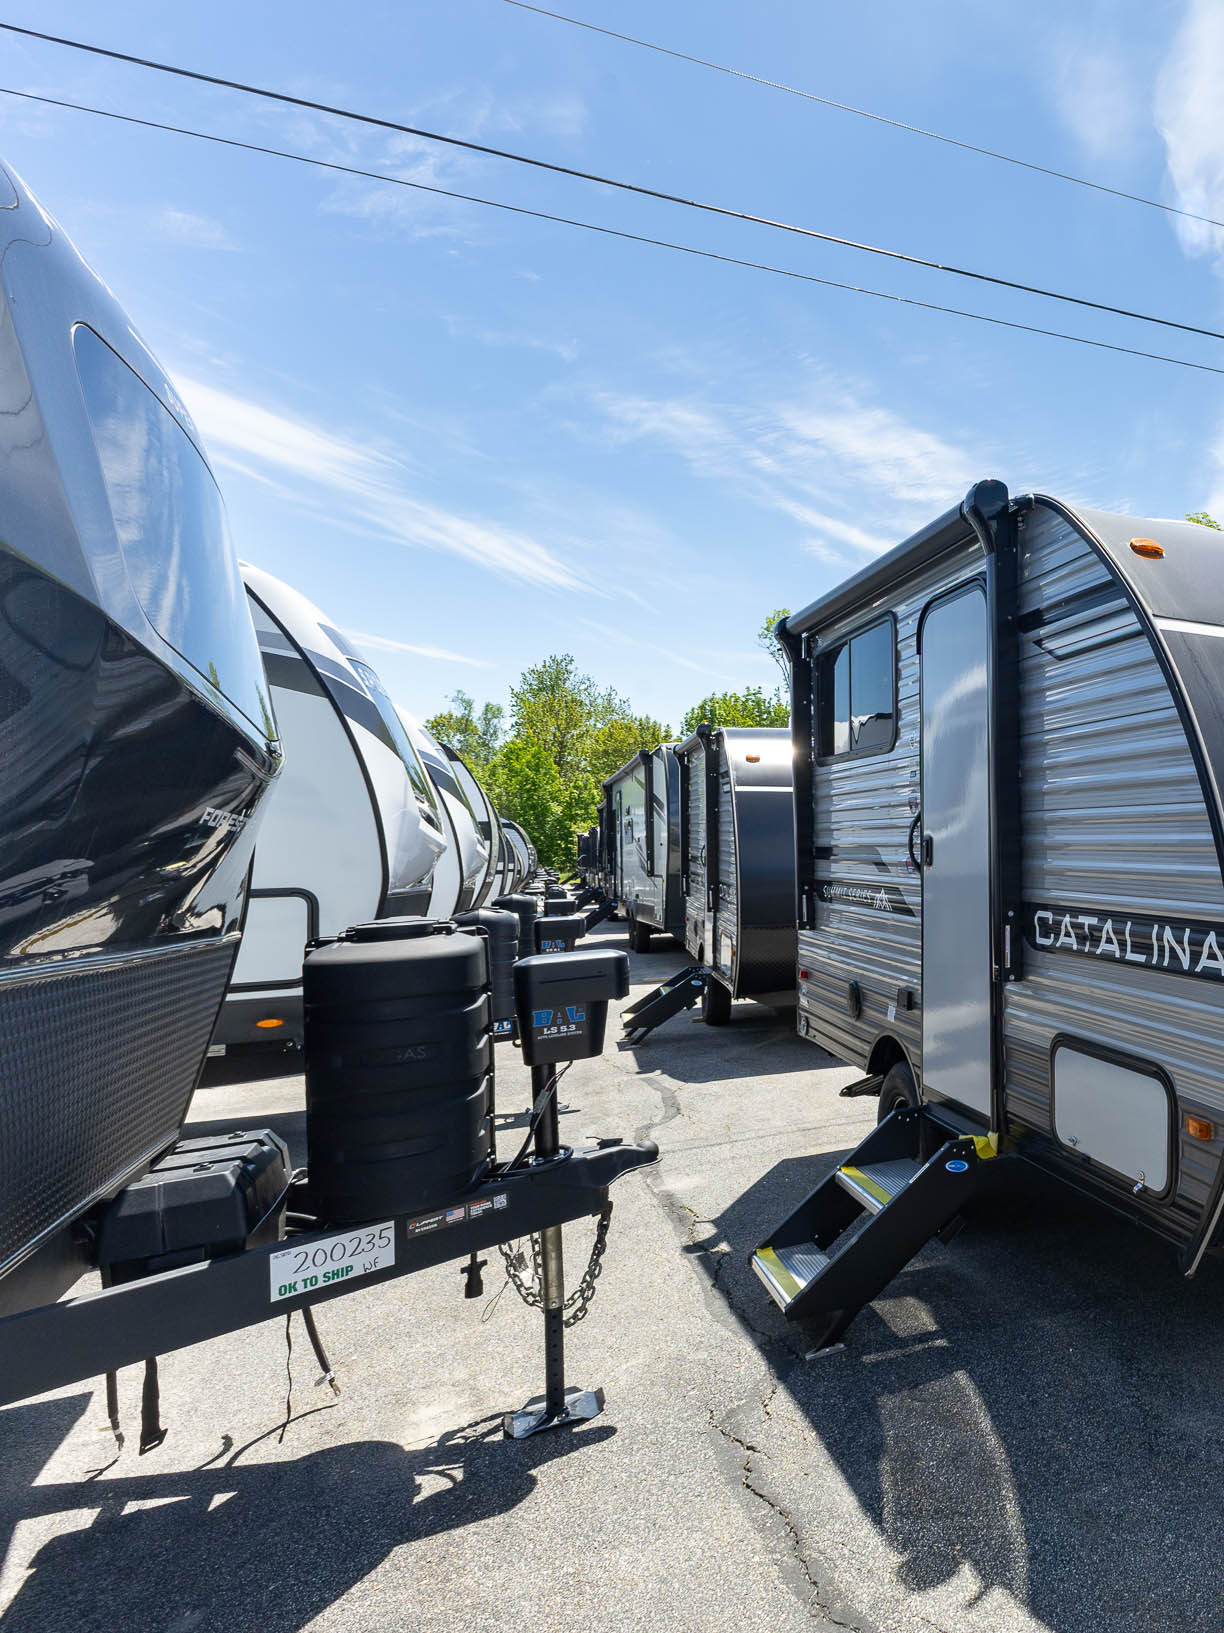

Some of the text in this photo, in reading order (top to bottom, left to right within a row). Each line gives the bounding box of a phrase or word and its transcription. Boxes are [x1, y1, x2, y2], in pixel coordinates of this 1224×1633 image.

[822, 885, 847, 898] SUMMIT
[532, 1006, 585, 1027] BAL
[543, 1027, 558, 1035] LS
[292, 1226, 393, 1274] 200235
[278, 1264, 354, 1296] OK TO SHIP
